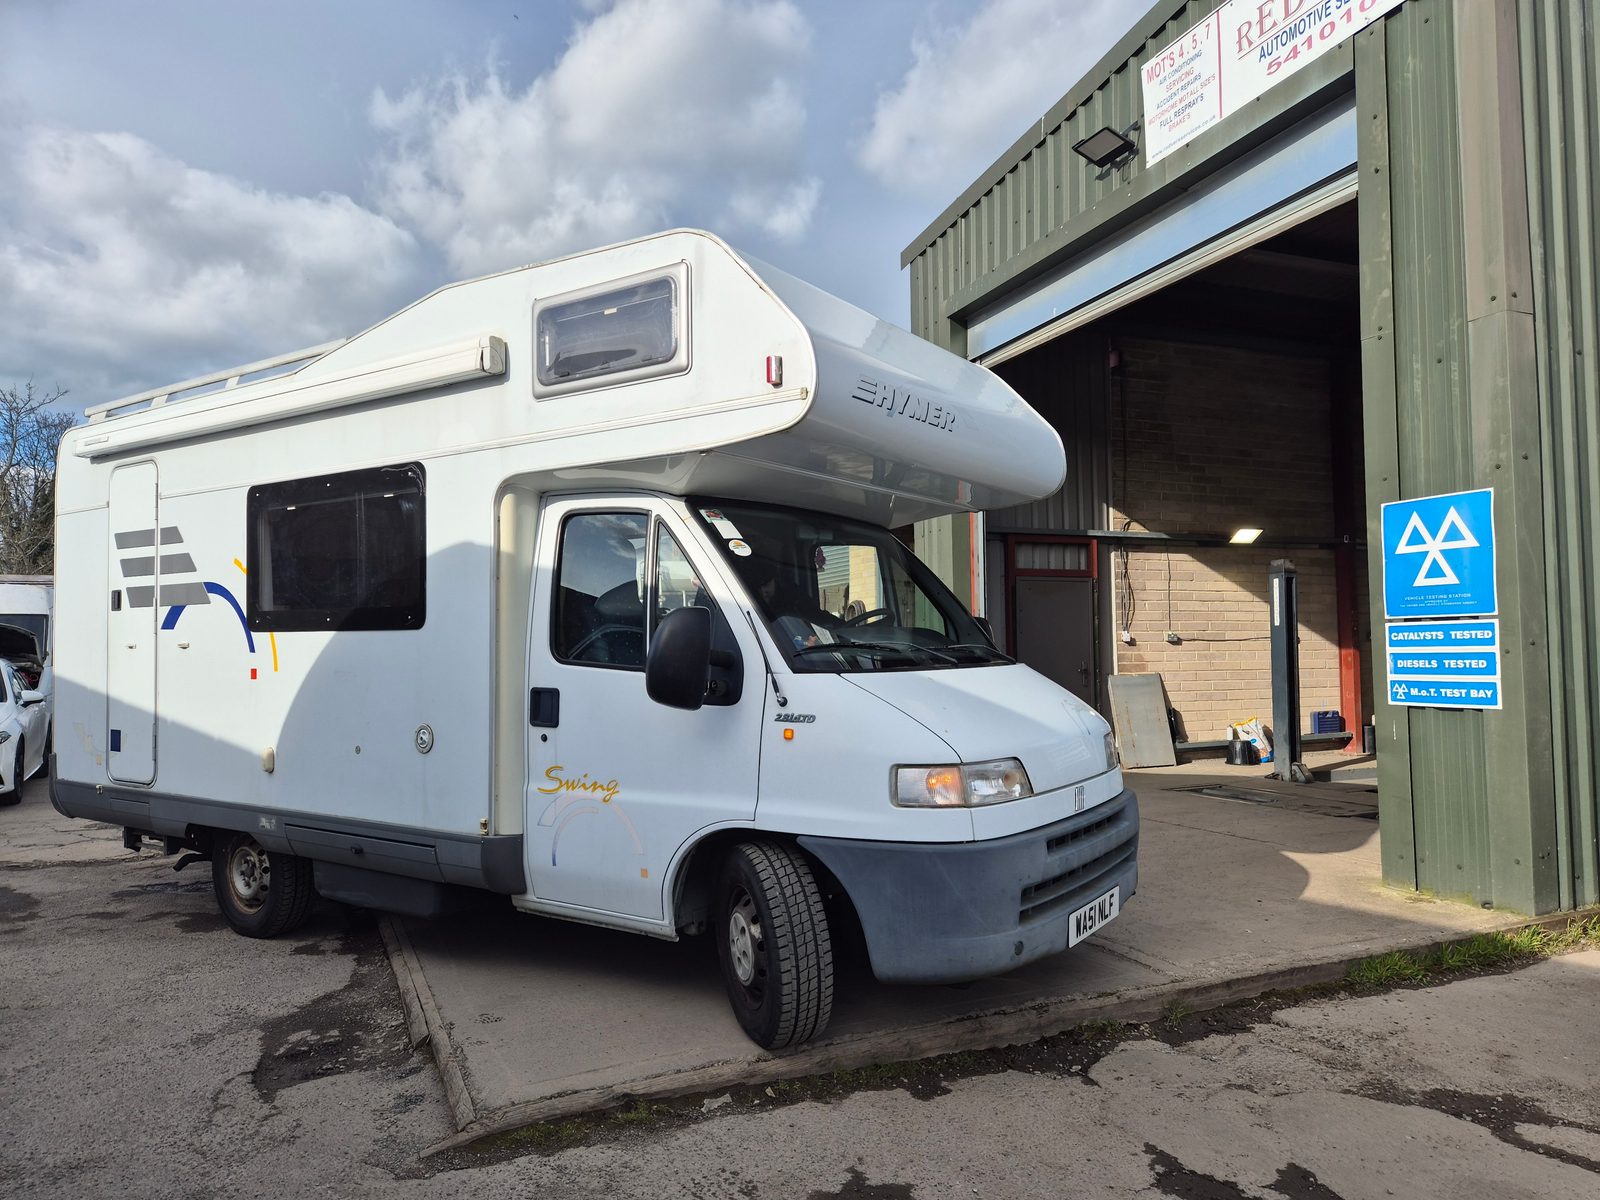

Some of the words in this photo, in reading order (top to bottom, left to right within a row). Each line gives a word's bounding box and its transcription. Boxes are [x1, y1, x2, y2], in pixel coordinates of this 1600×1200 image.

[1258, 0, 1332, 63] AUTOMOTIVE
[1146, 51, 1175, 84] MOT'S
[1159, 74, 1168, 86] AIR
[1167, 49, 1202, 79] CONDITIONING
[1165, 67, 1194, 93] SERVICING
[1157, 88, 1180, 110] ACCIDENT
[1180, 73, 1202, 92] REPAIRS
[1179, 92, 1189, 105] MOT
[1190, 86, 1200, 98] ALL
[1160, 115, 1173, 130] FULL
[1174, 93, 1204, 119] RESPRAY'S
[874, 383, 956, 433] HYMER
[1390, 631, 1445, 641] CATALYSTS
[1449, 630, 1493, 640] TESTED
[1397, 659, 1438, 668] DIESELS
[1443, 659, 1487, 669] TESTED
[1439, 688, 1468, 698] TEST
[1470, 689, 1494, 699] BAY
[537, 765, 620, 803] Swing
[1098, 892, 1115, 924] NLF
